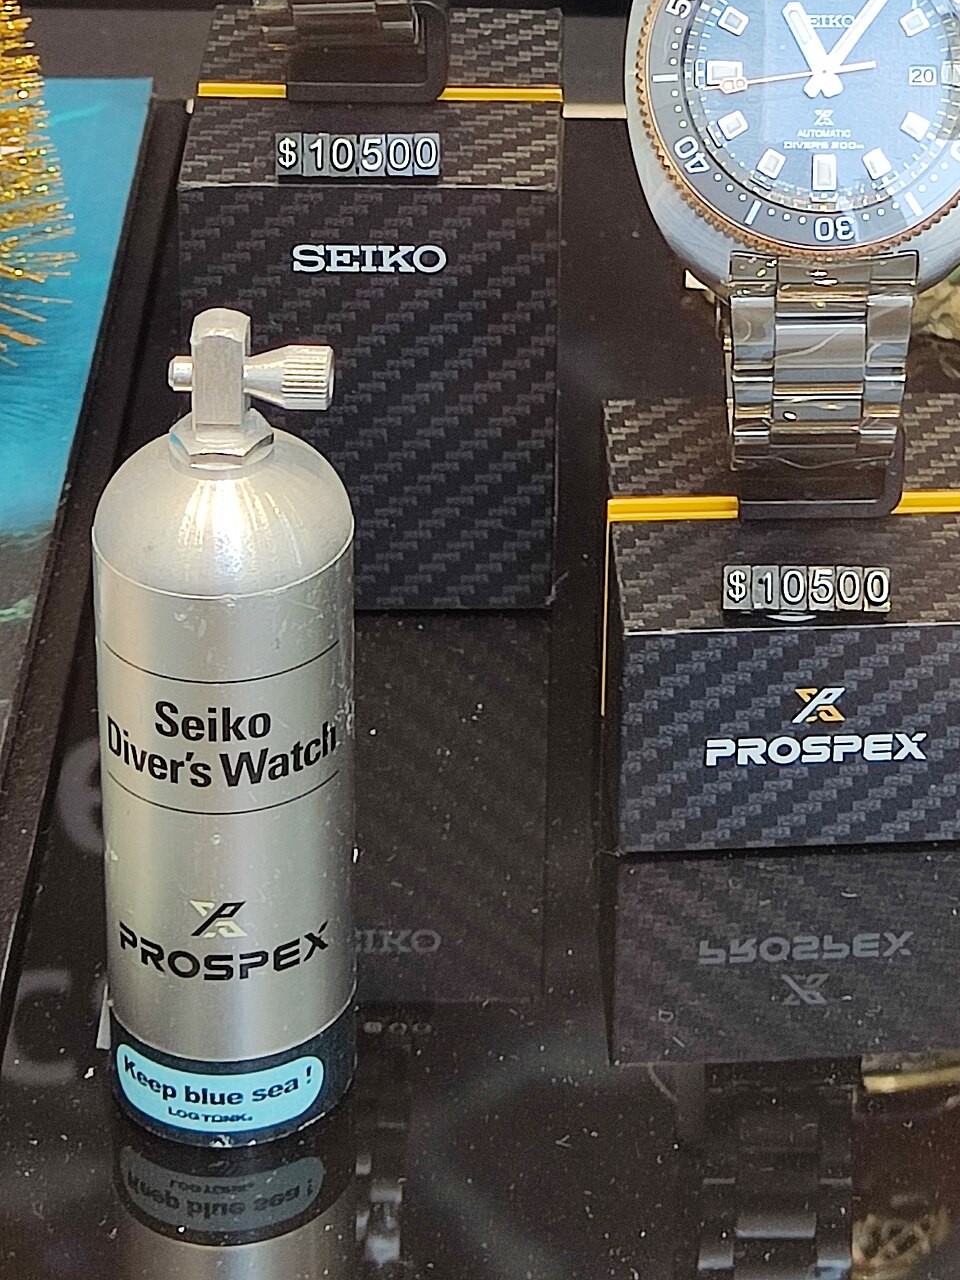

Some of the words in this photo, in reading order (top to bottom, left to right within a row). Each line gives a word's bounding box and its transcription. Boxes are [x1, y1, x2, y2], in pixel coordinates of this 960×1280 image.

[807, 15, 855, 28] EIKO
[911, 69, 934, 83] 20
[797, 129, 852, 138] AUTOMATIC
[277, 137, 438, 170] $10500
[674, 136, 710, 174] 40
[814, 217, 856, 242] 30
[292, 243, 448, 273] SEIKO
[726, 569, 890, 606] $10500
[154, 700, 272, 743] Seiko
[107, 715, 213, 788] Diver's
[219, 721, 337, 788] Watch
[705, 732, 928, 767] PROSPEX
[118, 921, 329, 981] PROSPEX
[123, 1055, 177, 1101] Keep
[184, 1085, 244, 1105] blue
[251, 1077, 299, 1103] sea
